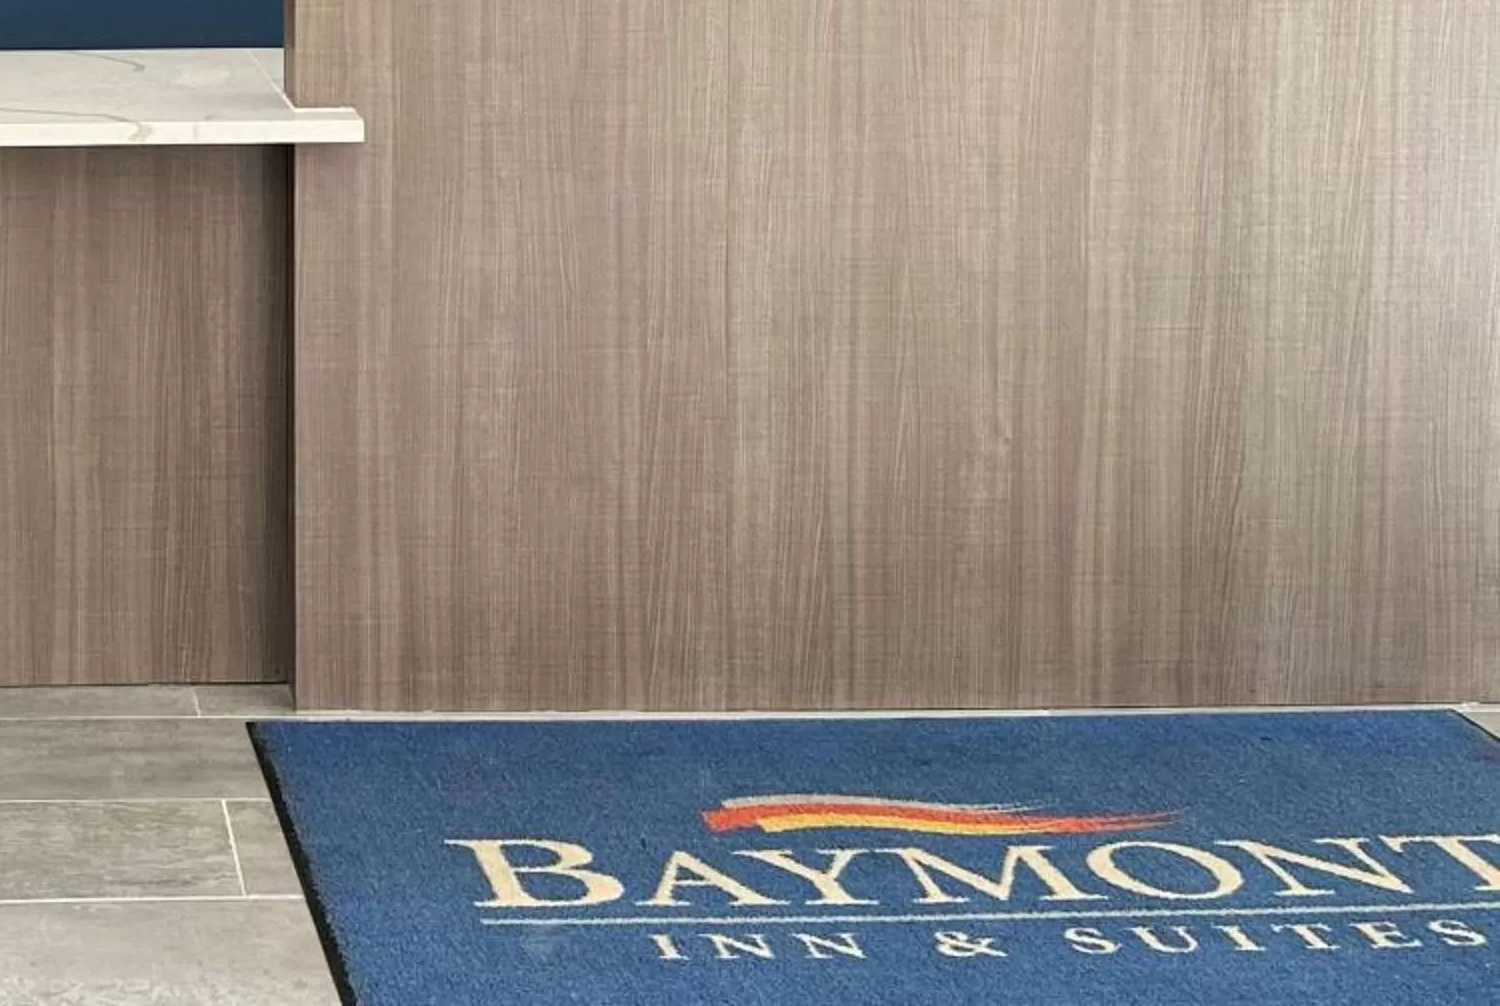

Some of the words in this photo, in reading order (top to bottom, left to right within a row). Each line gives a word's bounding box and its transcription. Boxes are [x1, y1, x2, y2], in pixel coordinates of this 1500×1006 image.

[444, 832, 1500, 909] BAYMONT
[652, 931, 869, 961] INN
[934, 929, 1007, 959] &
[1062, 918, 1489, 957] SUITES
